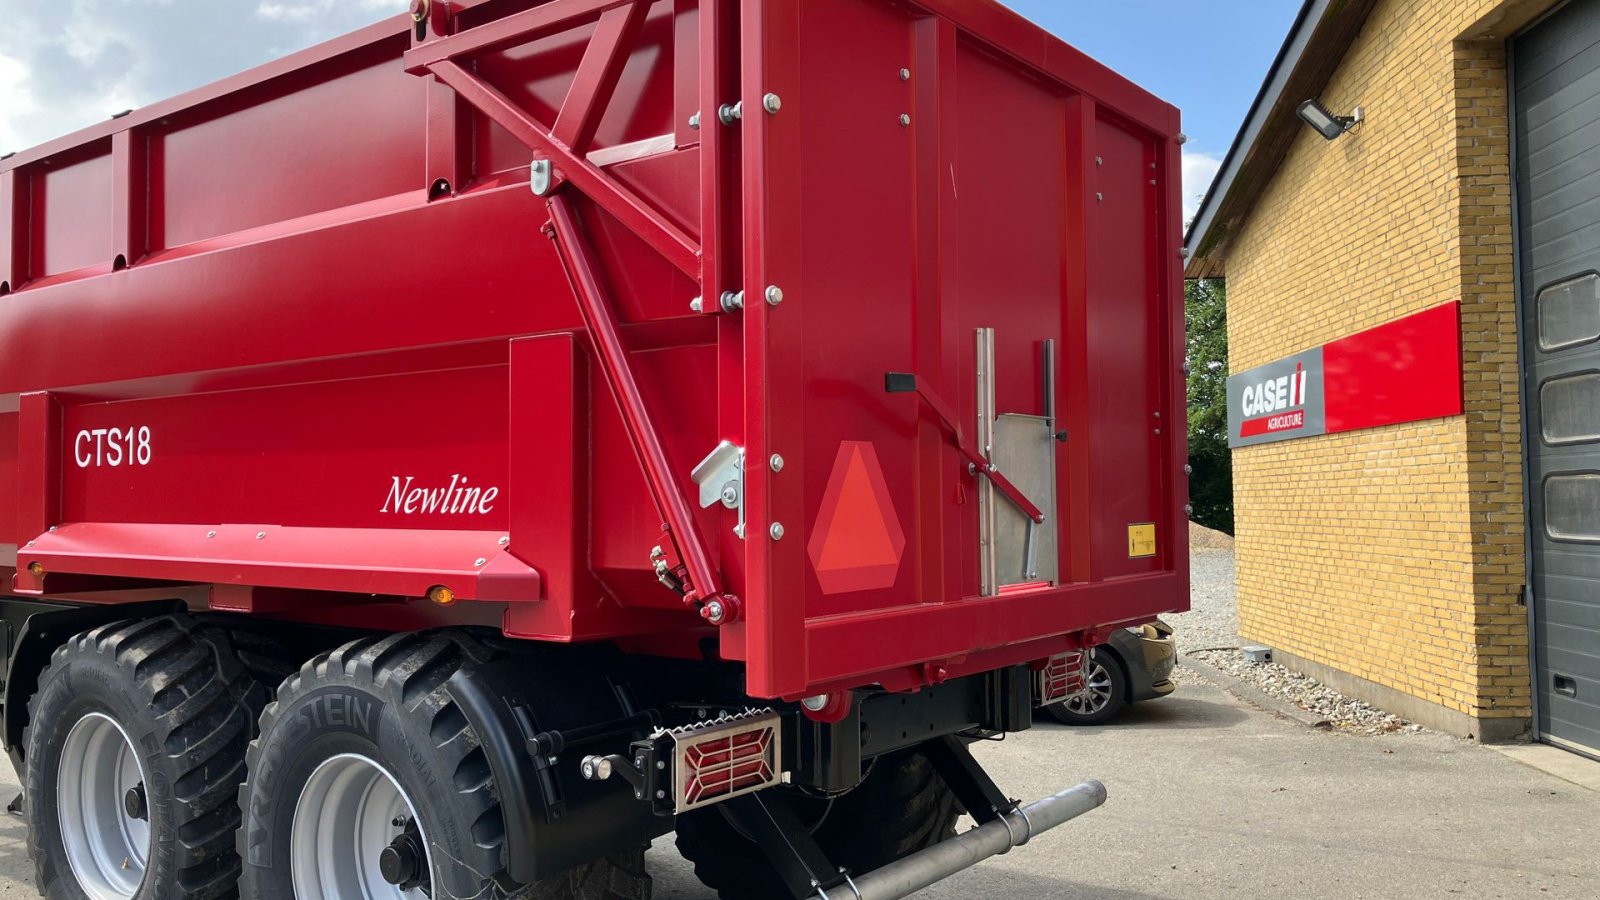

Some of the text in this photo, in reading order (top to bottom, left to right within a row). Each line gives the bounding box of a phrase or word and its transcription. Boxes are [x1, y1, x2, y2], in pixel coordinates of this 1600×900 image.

[1242, 376, 1288, 417] CASE
[1267, 413, 1303, 431] AGRICULTURE
[75, 426, 151, 468] CTS18
[379, 473, 499, 515] Newline
